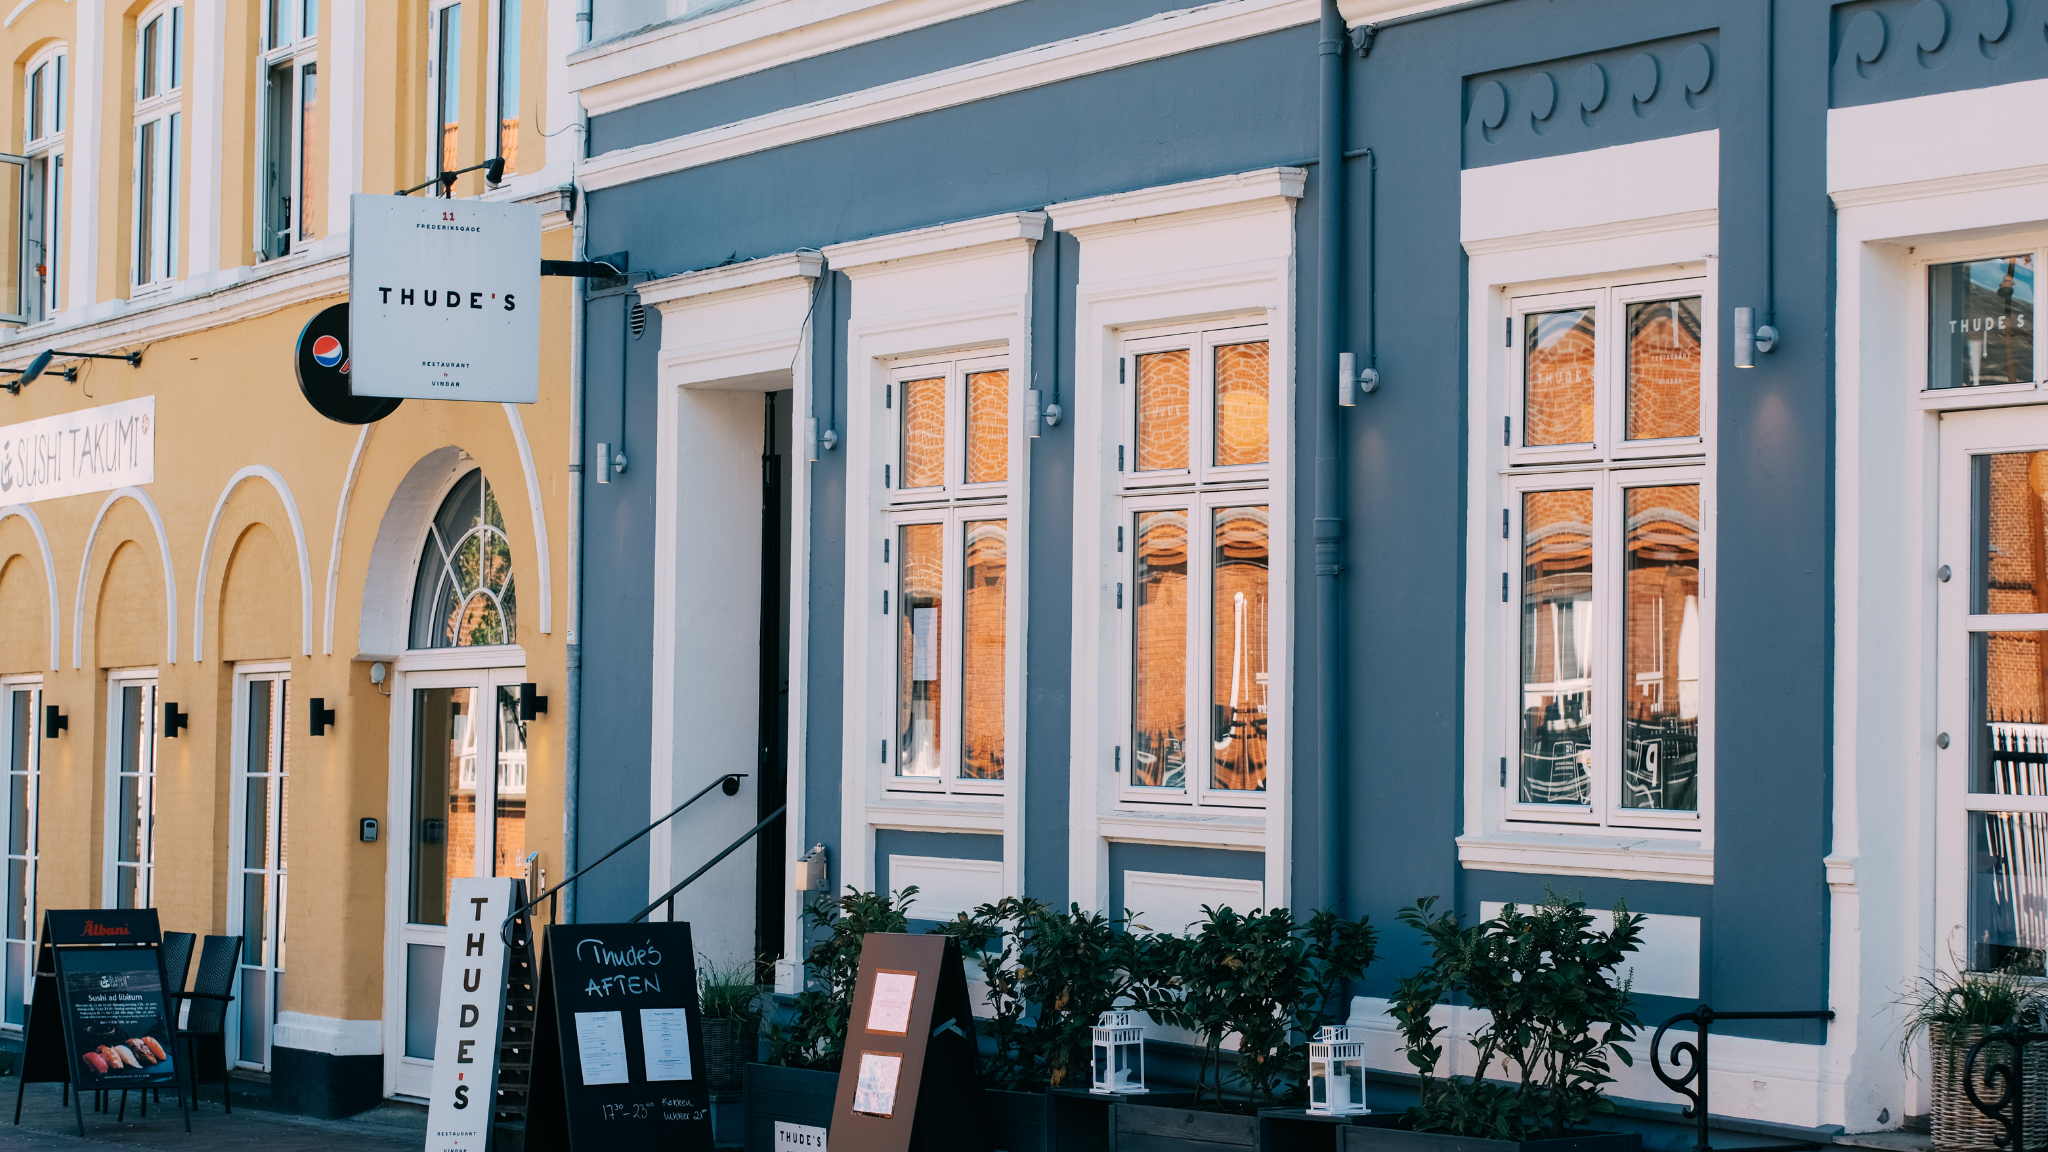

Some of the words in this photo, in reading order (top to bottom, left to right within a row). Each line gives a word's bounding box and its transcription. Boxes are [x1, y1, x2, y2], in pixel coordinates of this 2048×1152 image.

[442, 211, 456, 221] 11
[416, 223, 481, 233] FREDERIKSGADE
[378, 286, 516, 311] THUDE'S
[421, 360, 470, 368] RESTAURANT
[16, 430, 63, 488] SUSHI
[68, 414, 140, 479] TAKUMI
[80, 921, 131, 936] Albani
[584, 972, 661, 998] AFTEN
[88, 993, 107, 1002] Sushi
[108, 993, 117, 1001] ad
[118, 993, 143, 1001] libitum
[453, 897, 489, 1110] THUDE'S
[779, 1130, 822, 1148] THUDE'S
